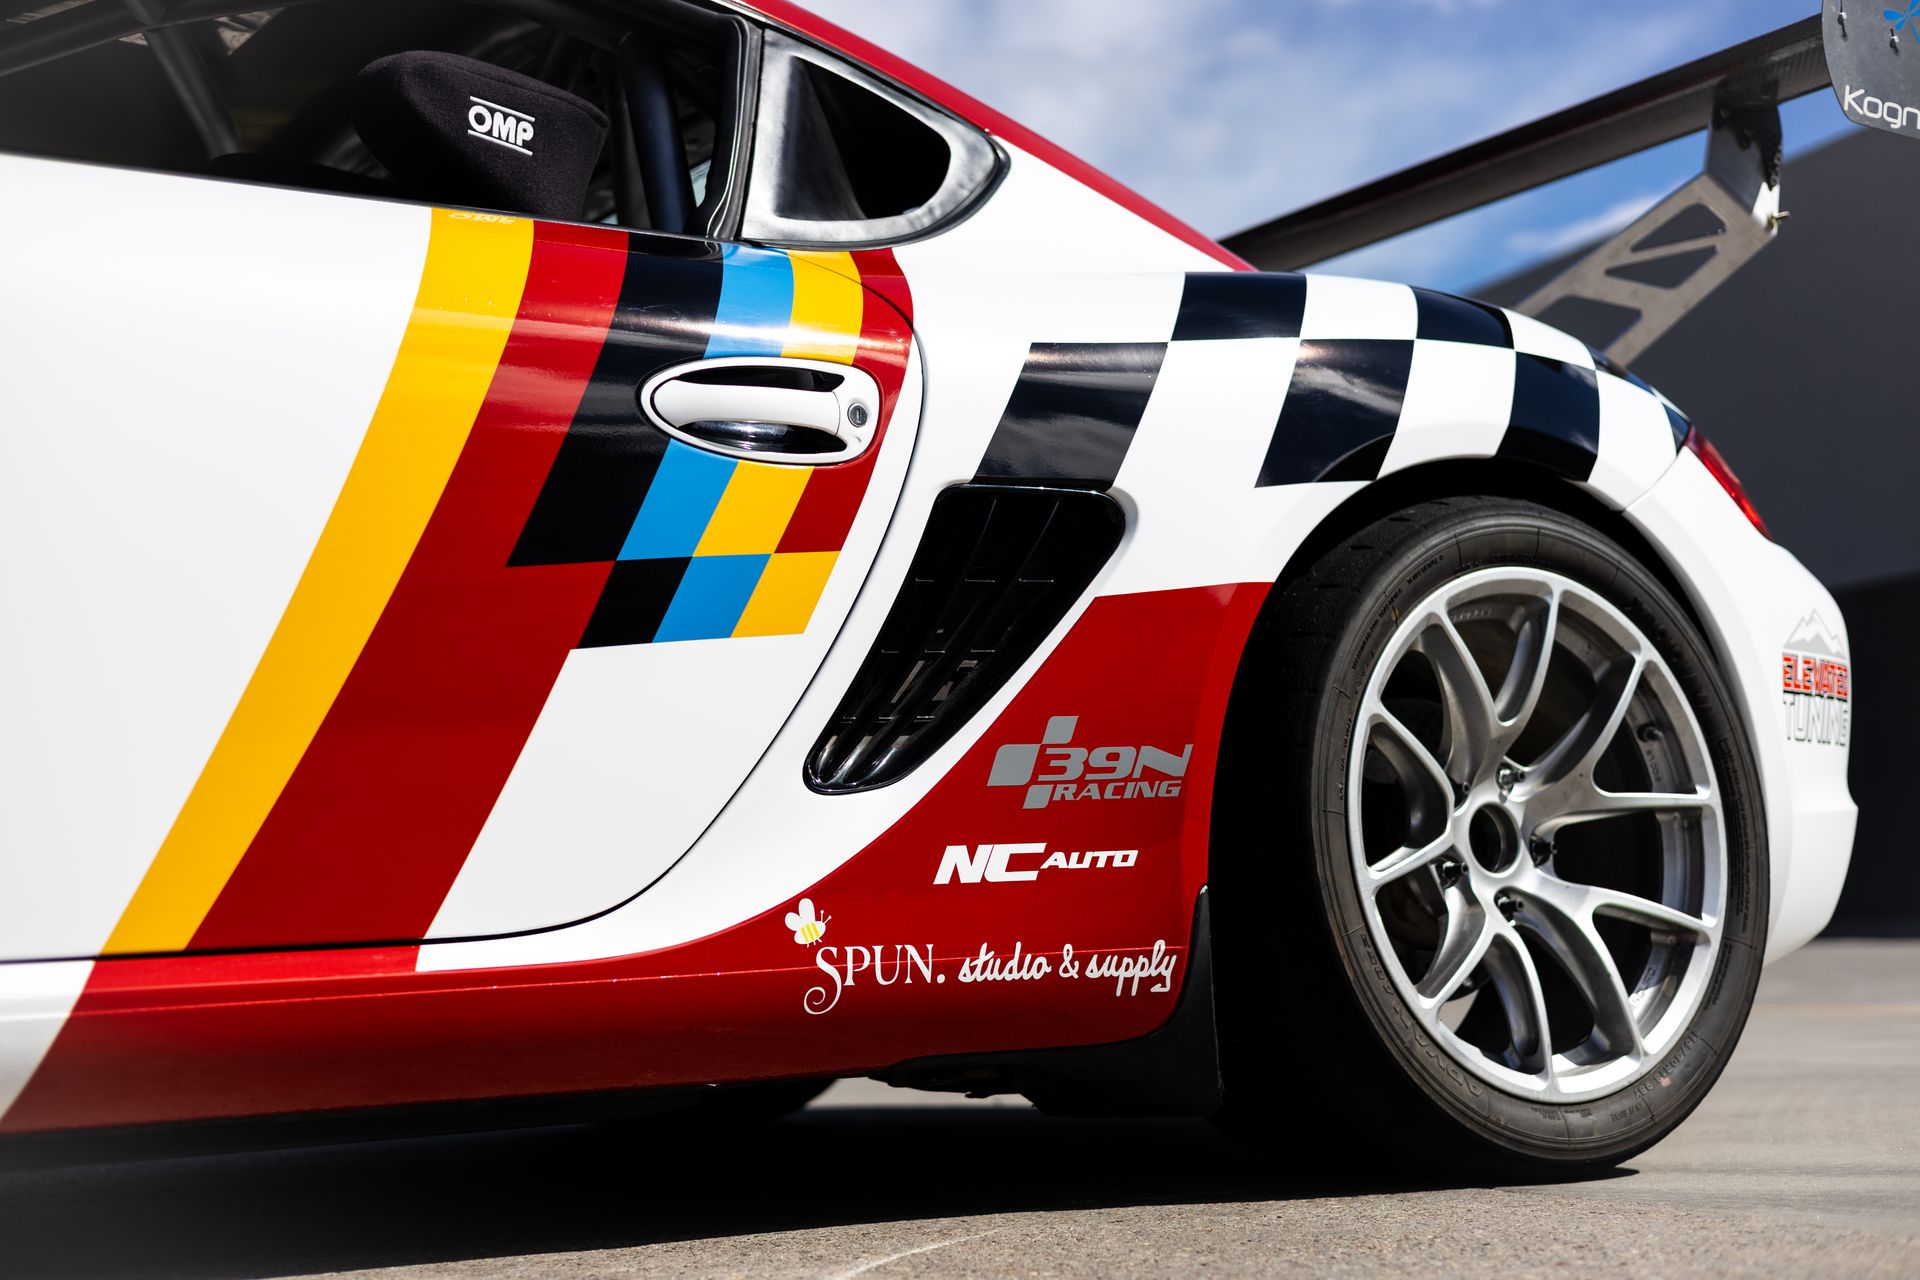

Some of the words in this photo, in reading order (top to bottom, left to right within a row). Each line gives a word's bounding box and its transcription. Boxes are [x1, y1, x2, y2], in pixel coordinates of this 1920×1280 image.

[468, 105, 534, 146] OMP
[1037, 744, 1193, 781] 39N
[1053, 780, 1182, 801] RACING
[933, 843, 1047, 884] NC
[1040, 850, 1139, 869] AUTO
[803, 944, 945, 1015] SPUN.
[958, 942, 1052, 982] studio
[1058, 943, 1079, 979] &
[1084, 940, 1177, 997] supply
